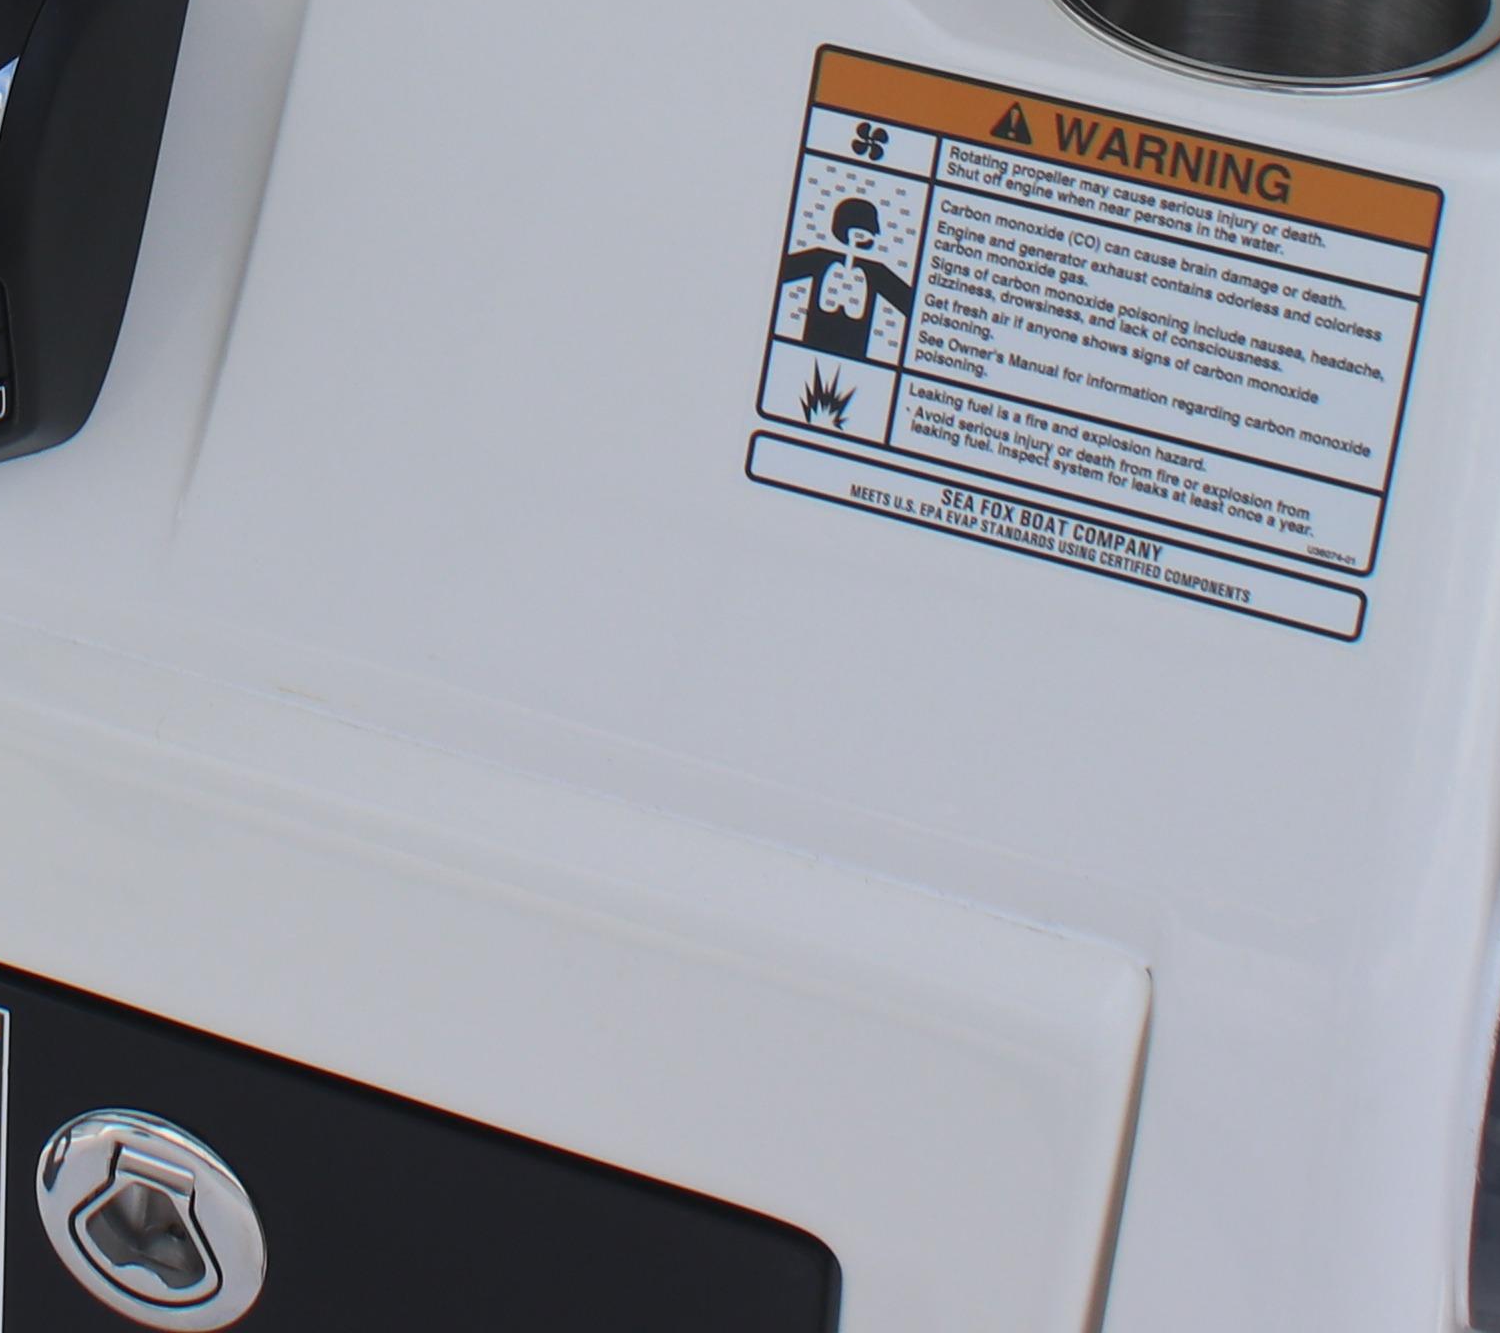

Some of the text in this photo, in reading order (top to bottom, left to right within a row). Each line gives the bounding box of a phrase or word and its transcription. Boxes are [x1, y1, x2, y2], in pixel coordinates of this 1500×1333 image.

[946, 161, 1284, 255] Shut off engine when near persons in the water.
[949, 145, 1326, 248] Rotating propeller may cause serious injury or death.
[1055, 112, 1292, 204] WARNING
[933, 239, 1088, 287] carbon monoxide gas.
[936, 220, 1383, 342] Engine and generator exhaust contains odorless and colorless
[940, 199, 1346, 311] Carbon monoxide (CO) can cause brain damage or death.
[927, 272, 1282, 372] dizziness, drowsiness, and lack of consciousness.
[930, 255, 1384, 382] Signs of carbon monoxide poisoning include nausea, headache,
[908, 382, 1206, 472] Leaking fuel is a fire and explosion hazard.
[850, 484, 1251, 604] MEETS U.S. EPA EVAP STANDARDS USING CERTIFIED COMPONENTS
[941, 488, 1163, 562] SEA FOX BOAT COMPANY
